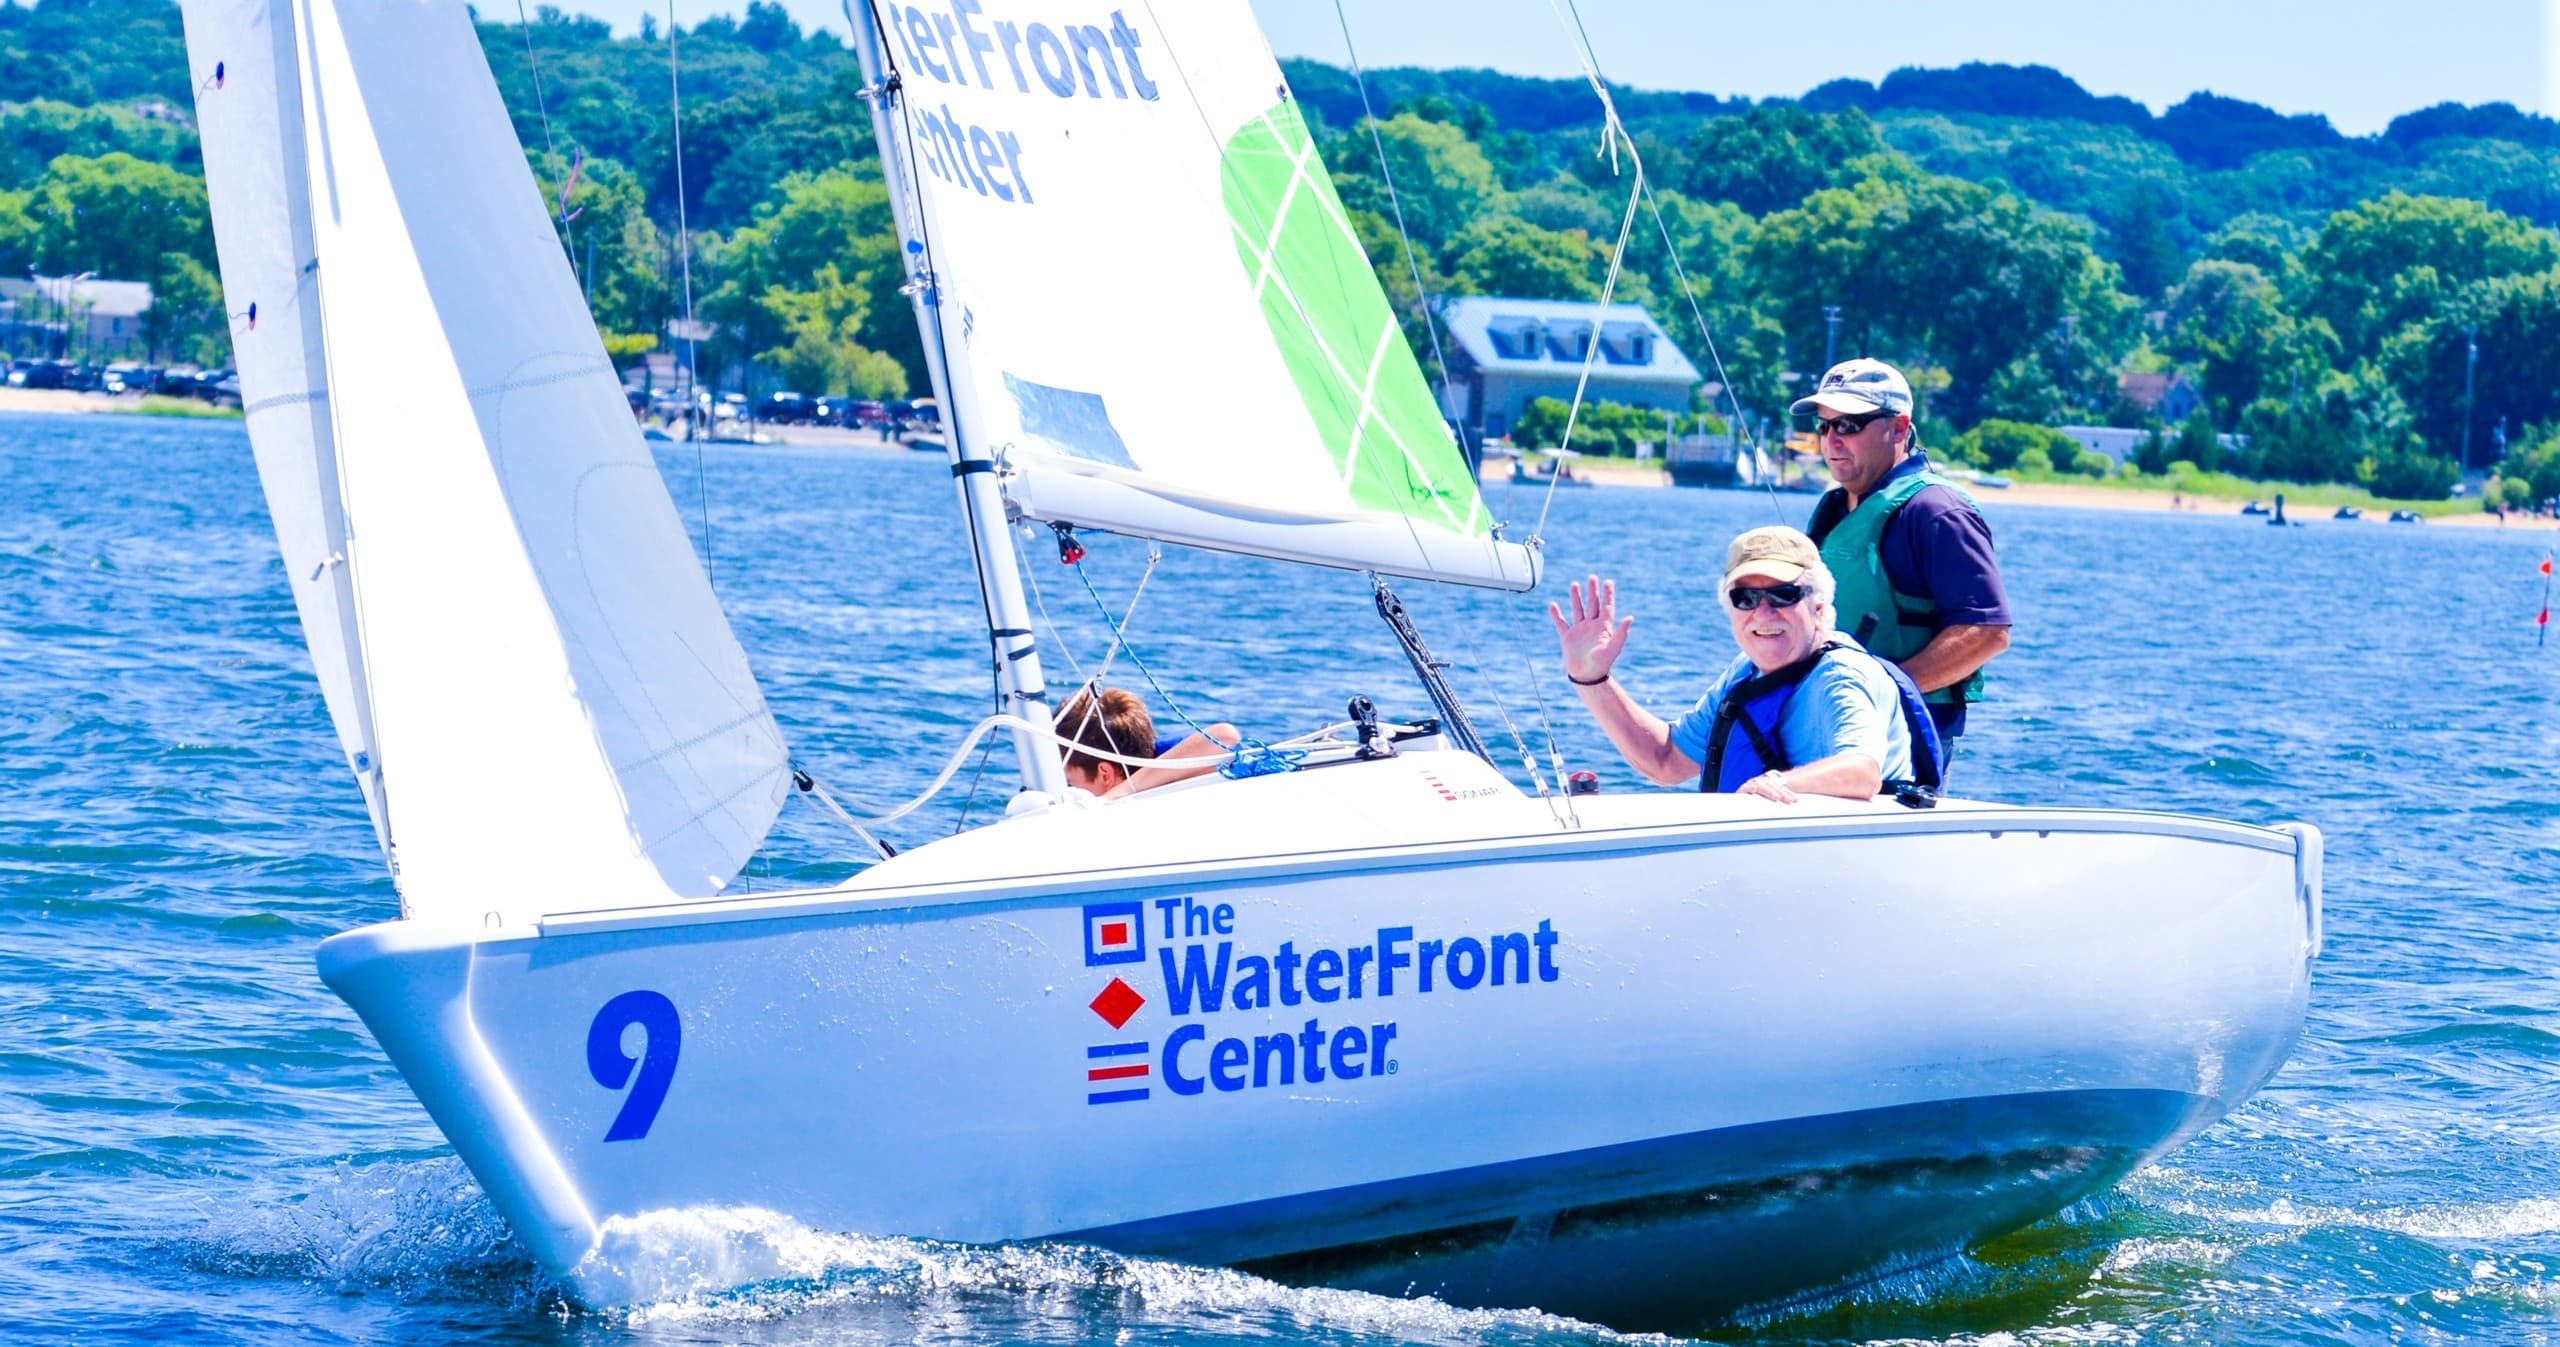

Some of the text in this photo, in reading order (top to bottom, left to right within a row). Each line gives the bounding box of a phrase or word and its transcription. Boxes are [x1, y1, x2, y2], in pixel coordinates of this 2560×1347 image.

[1156, 897, 1235, 939] The
[1158, 918, 1560, 1016] WaterFront
[586, 989, 682, 1143] 9
